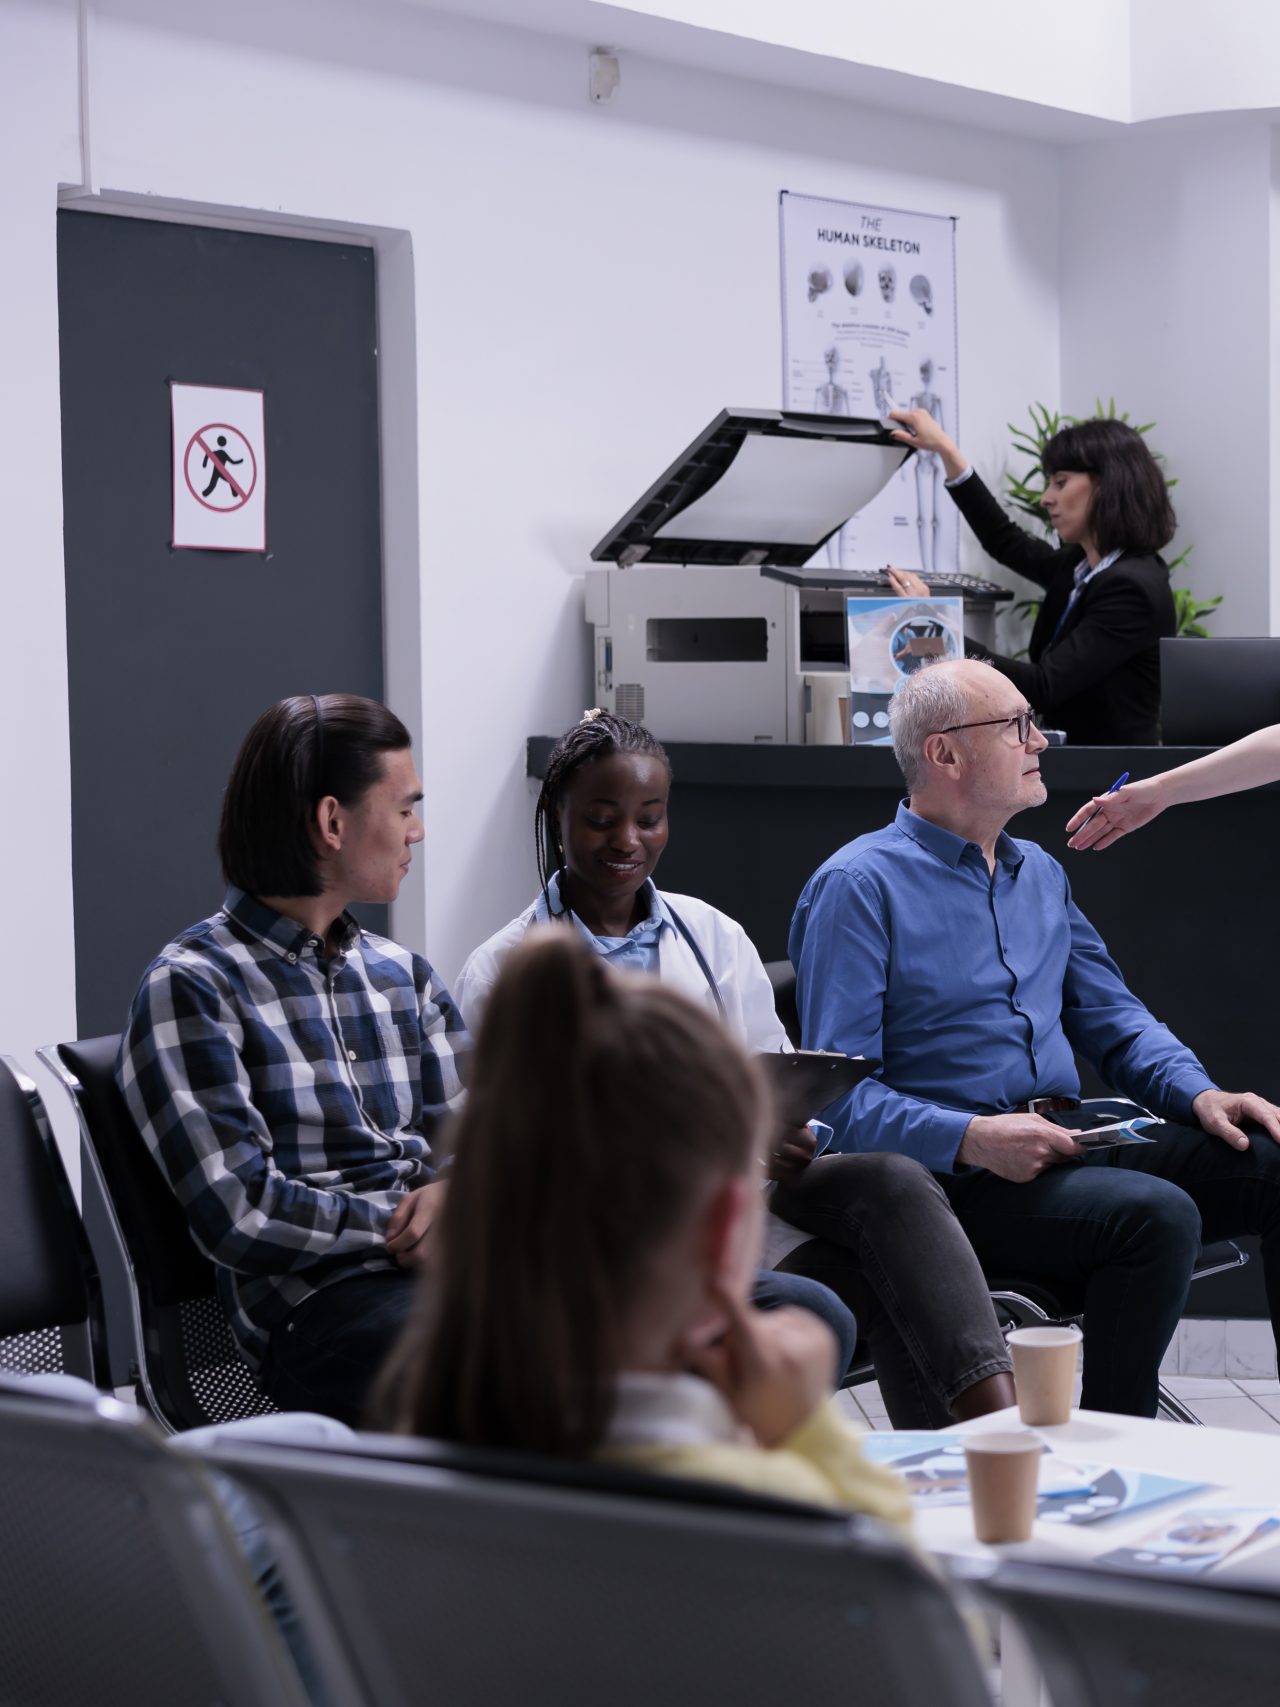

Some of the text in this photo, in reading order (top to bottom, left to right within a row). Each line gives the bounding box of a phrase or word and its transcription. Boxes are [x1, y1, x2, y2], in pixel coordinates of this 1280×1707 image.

[861, 216, 882, 232] THE
[817, 228, 920, 254] HUMAN SKELETON
